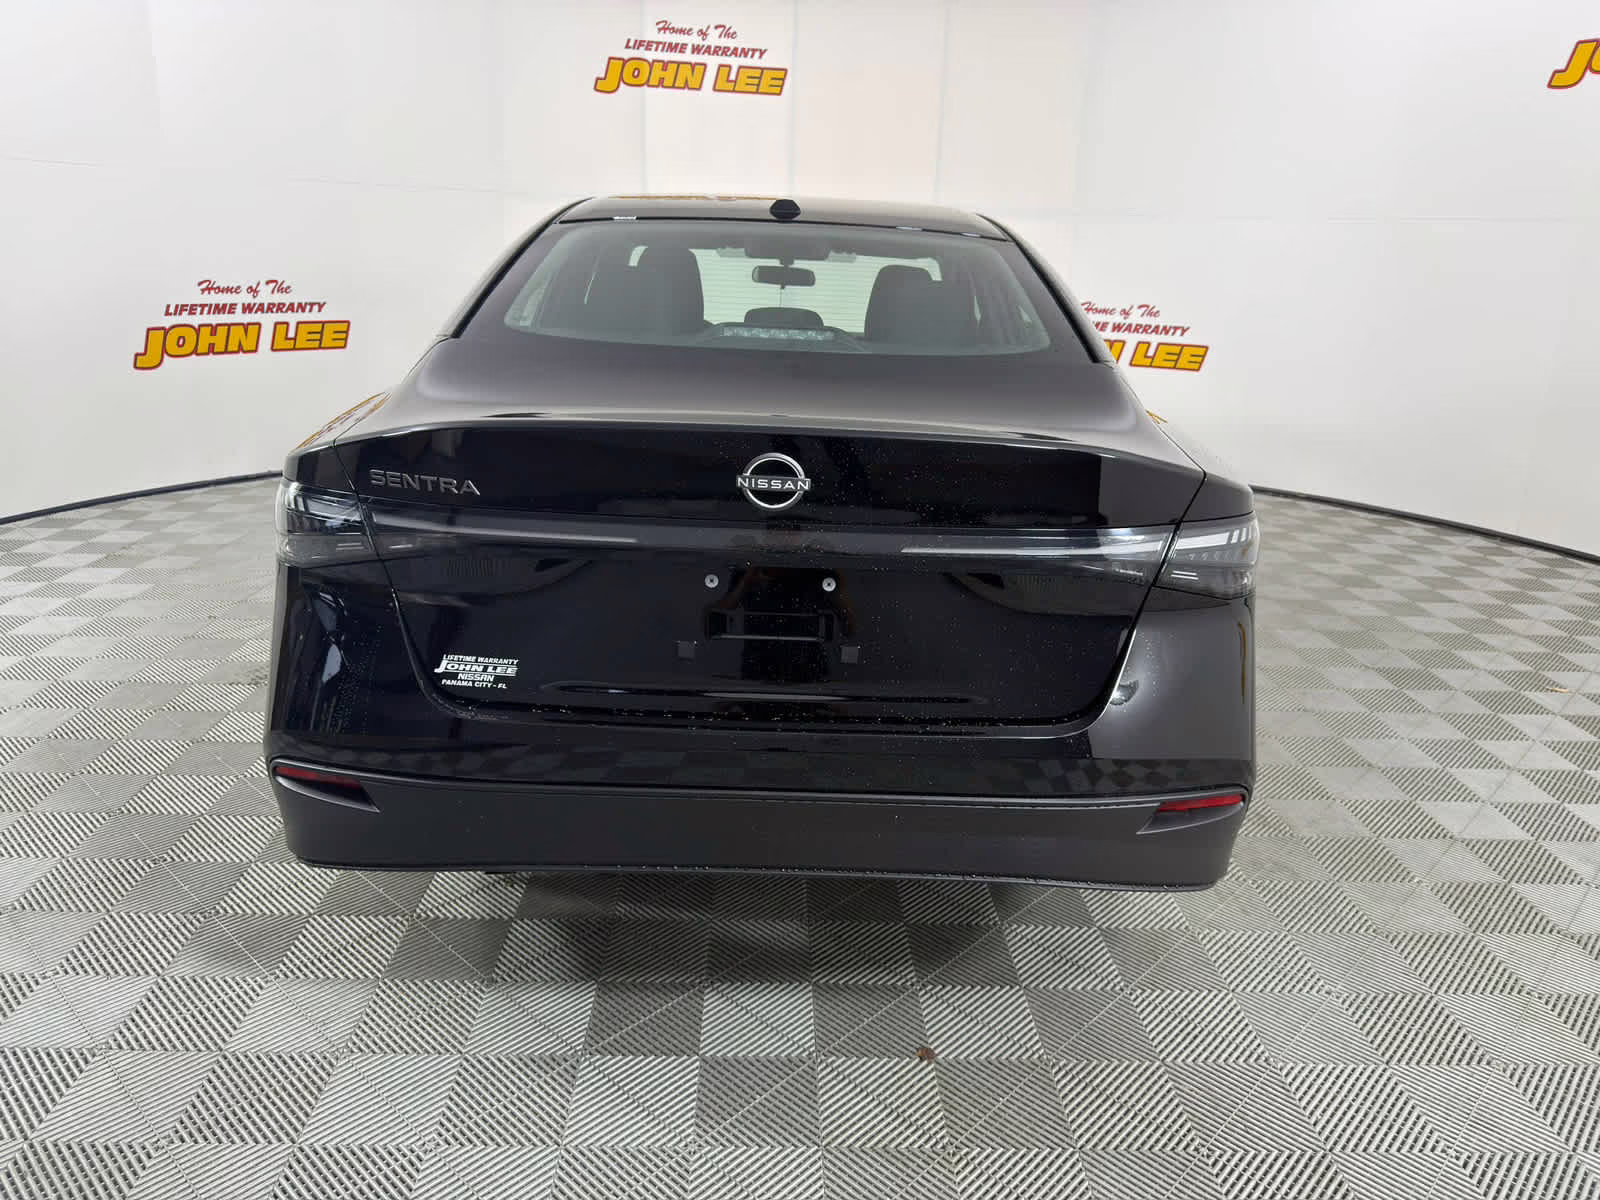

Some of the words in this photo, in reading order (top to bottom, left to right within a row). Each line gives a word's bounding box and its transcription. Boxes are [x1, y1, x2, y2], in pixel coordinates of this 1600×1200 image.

[655, 20, 693, 36] Home
[697, 25, 709, 41] of
[714, 24, 737, 40] The
[625, 38, 688, 54] LIFETIME
[691, 43, 767, 59] WARRANTY
[594, 56, 707, 93] JOHN
[712, 63, 788, 95] LEE
[198, 279, 242, 295] Home
[246, 281, 260, 298] of
[265, 279, 292, 294] The
[164, 303, 237, 316] LIFETIME
[241, 302, 326, 315] WARRANTY
[1081, 301, 1116, 316] Home
[1119, 304, 1134, 320] of
[1137, 304, 1160, 318] The
[1111, 322, 1190, 337] WARRANTY
[133, 322, 261, 370] JOHN
[271, 320, 350, 351] LEE
[1129, 341, 1209, 372] LEE
[369, 469, 480, 496] SENTRA
[737, 477, 809, 490] NISSAN
[434, 660, 485, 673] JOHN
[486, 666, 518, 674] LEE
[443, 654, 476, 662] LIFETIME
[477, 656, 519, 665] WARRANTY
[441, 679, 473, 687] PANAMA
[474, 681, 493, 689] CITY
[457, 673, 495, 682] NISSAN
